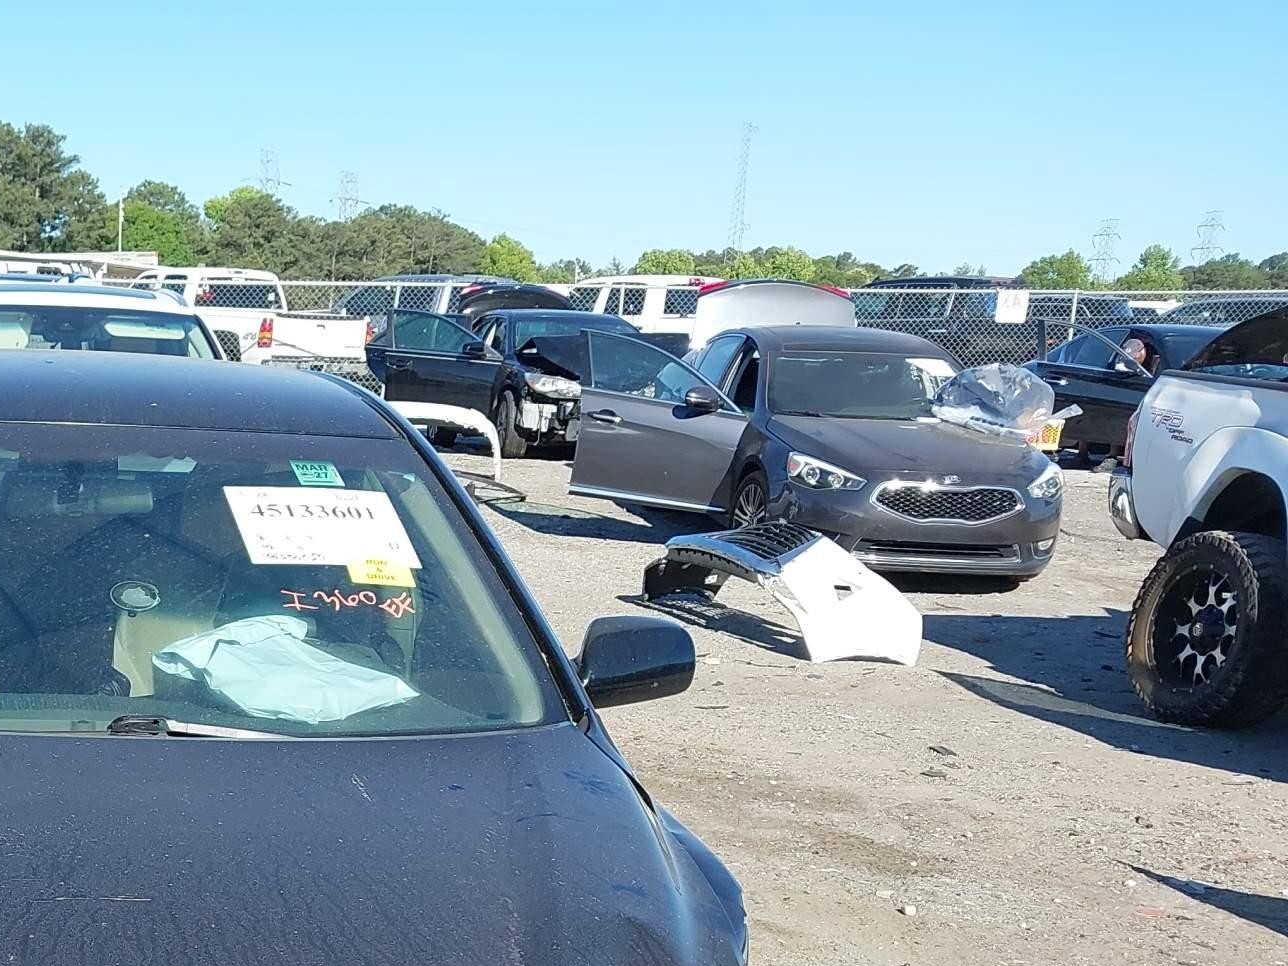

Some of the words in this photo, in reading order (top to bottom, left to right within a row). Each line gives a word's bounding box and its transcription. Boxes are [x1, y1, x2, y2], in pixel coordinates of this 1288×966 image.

[1151, 412, 1184, 428] TRD
[1171, 435, 1194, 444] ROAD
[294, 463, 328, 471] MAR
[250, 503, 375, 520] 45133601
